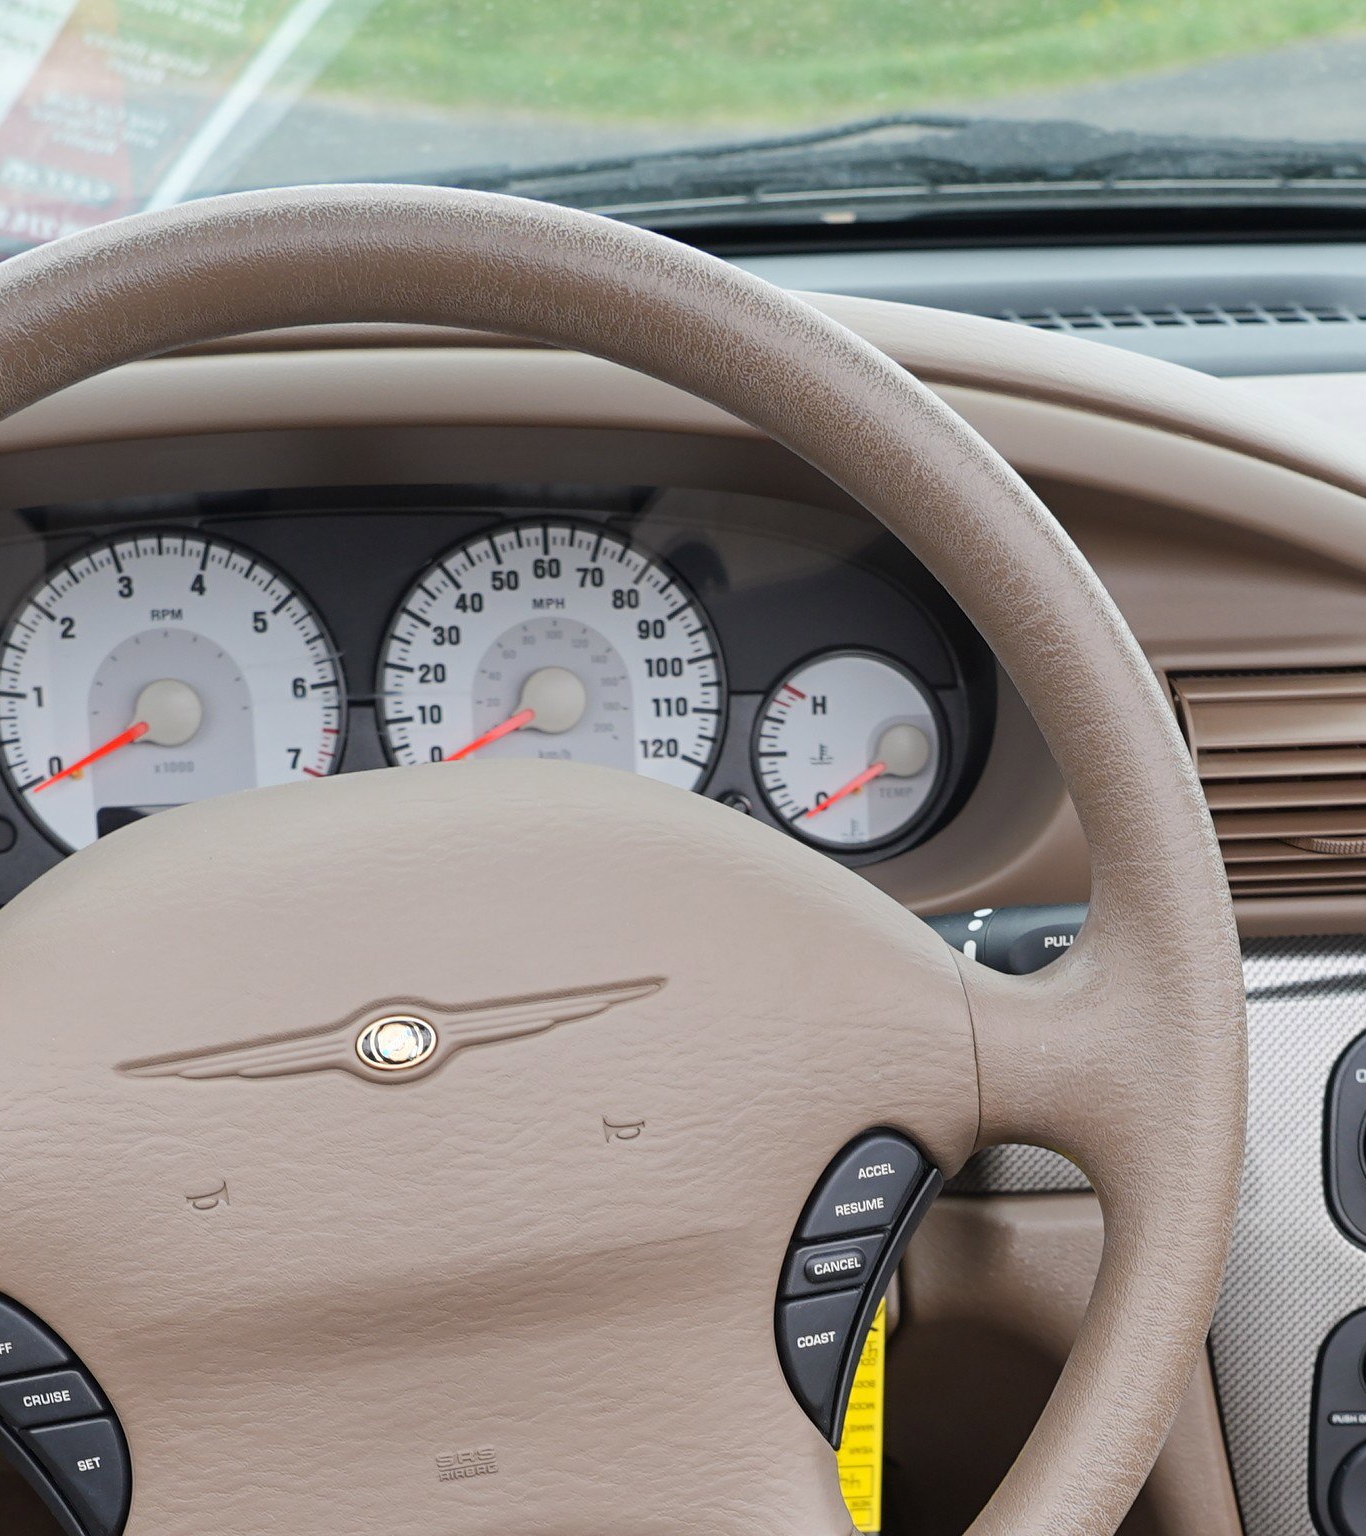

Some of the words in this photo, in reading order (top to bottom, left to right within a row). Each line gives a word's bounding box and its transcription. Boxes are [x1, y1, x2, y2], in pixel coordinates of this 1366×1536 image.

[533, 558, 561, 579] 60
[577, 568, 604, 588] 70
[117, 576, 134, 598] 3
[190, 574, 207, 596] 4
[491, 571, 519, 592] 50
[455, 593, 484, 614] 40
[532, 597, 566, 611] MPH
[612, 589, 640, 610] 80
[150, 608, 184, 622] RPM
[251, 610, 269, 633] 5
[59, 616, 76, 639] 2
[432, 625, 461, 647] 30
[638, 619, 666, 640] 90
[418, 664, 446, 684] 20
[646, 658, 683, 679] 100
[33, 686, 44, 707] 1
[292, 677, 308, 700] 6
[418, 705, 443, 726] 10
[653, 697, 688, 718] 110
[812, 696, 827, 716] H
[287, 749, 302, 771] 7
[430, 745, 444, 761] 0
[641, 739, 679, 760] 120
[48, 757, 64, 778] 0
[879, 785, 913, 800] TEMP
[857, 1162, 895, 1180] ACCEL
[834, 1197, 885, 1217] RESUME
[813, 1256, 862, 1276] CANCEL
[797, 1331, 836, 1349] COAST
[23, 1389, 71, 1408] CRUISE
[77, 1456, 101, 1472] SET
[436, 1448, 496, 1468] SRS
[439, 1464, 499, 1482] AIRBAG
